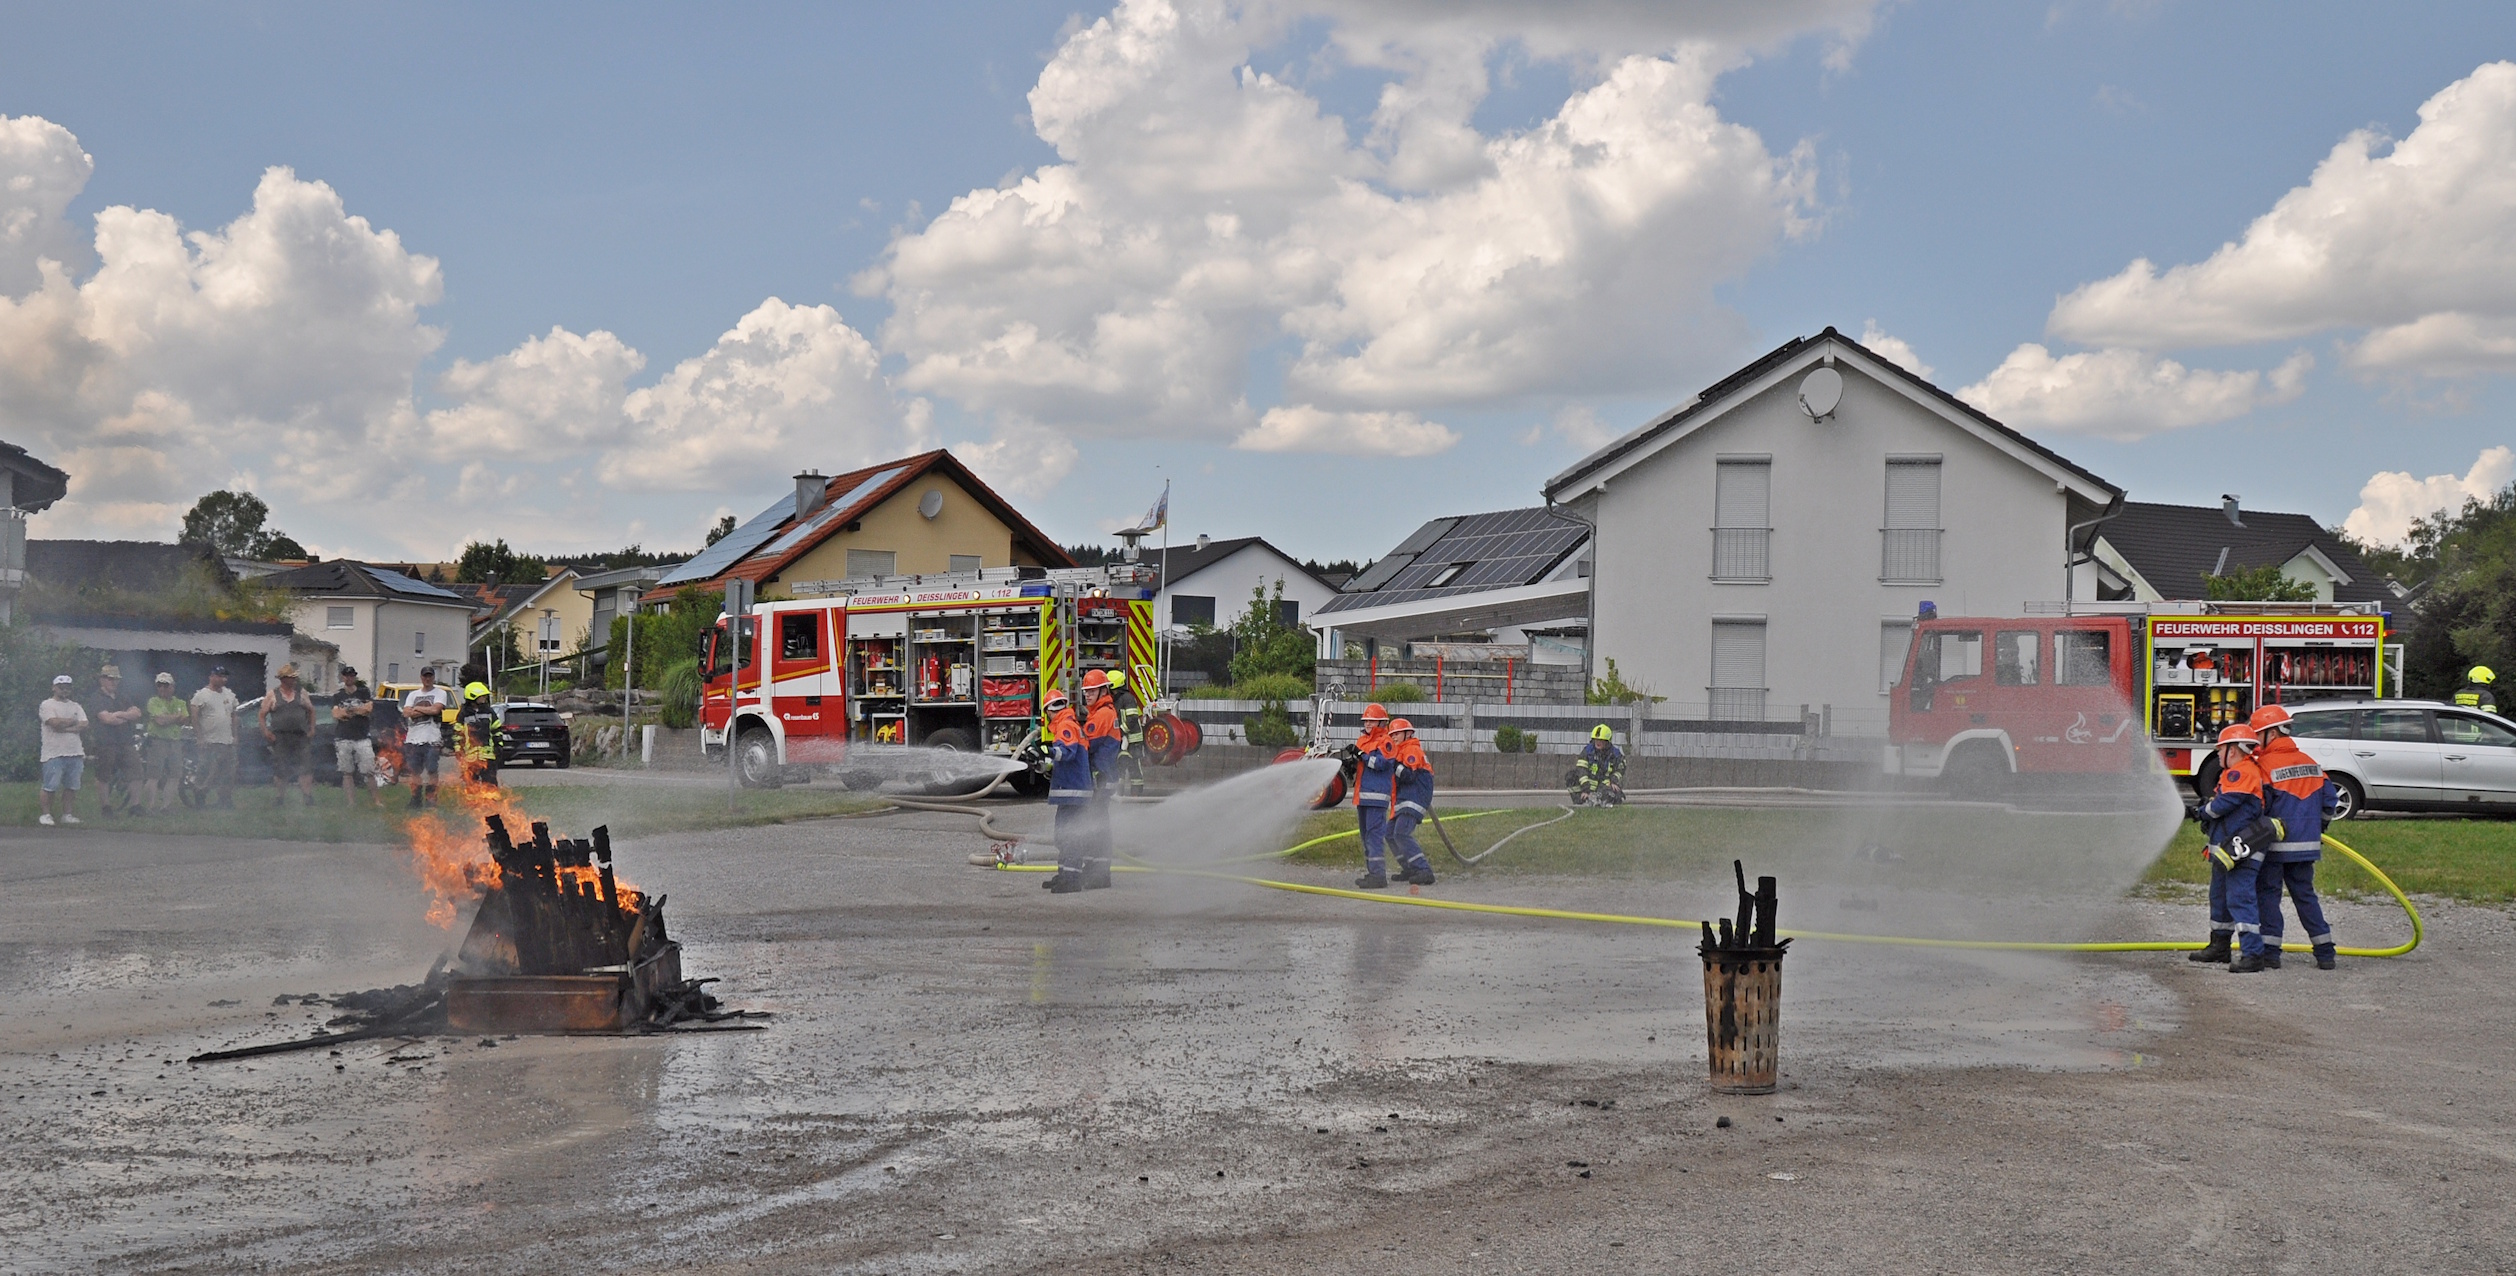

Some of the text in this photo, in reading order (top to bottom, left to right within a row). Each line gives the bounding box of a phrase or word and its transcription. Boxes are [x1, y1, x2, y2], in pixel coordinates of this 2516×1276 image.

[852, 589, 1012, 605] FEUERWEHR DEISSLINGEN 112
[2156, 623, 2375, 635] FEUERWEHR DEISSLINGEN 112
